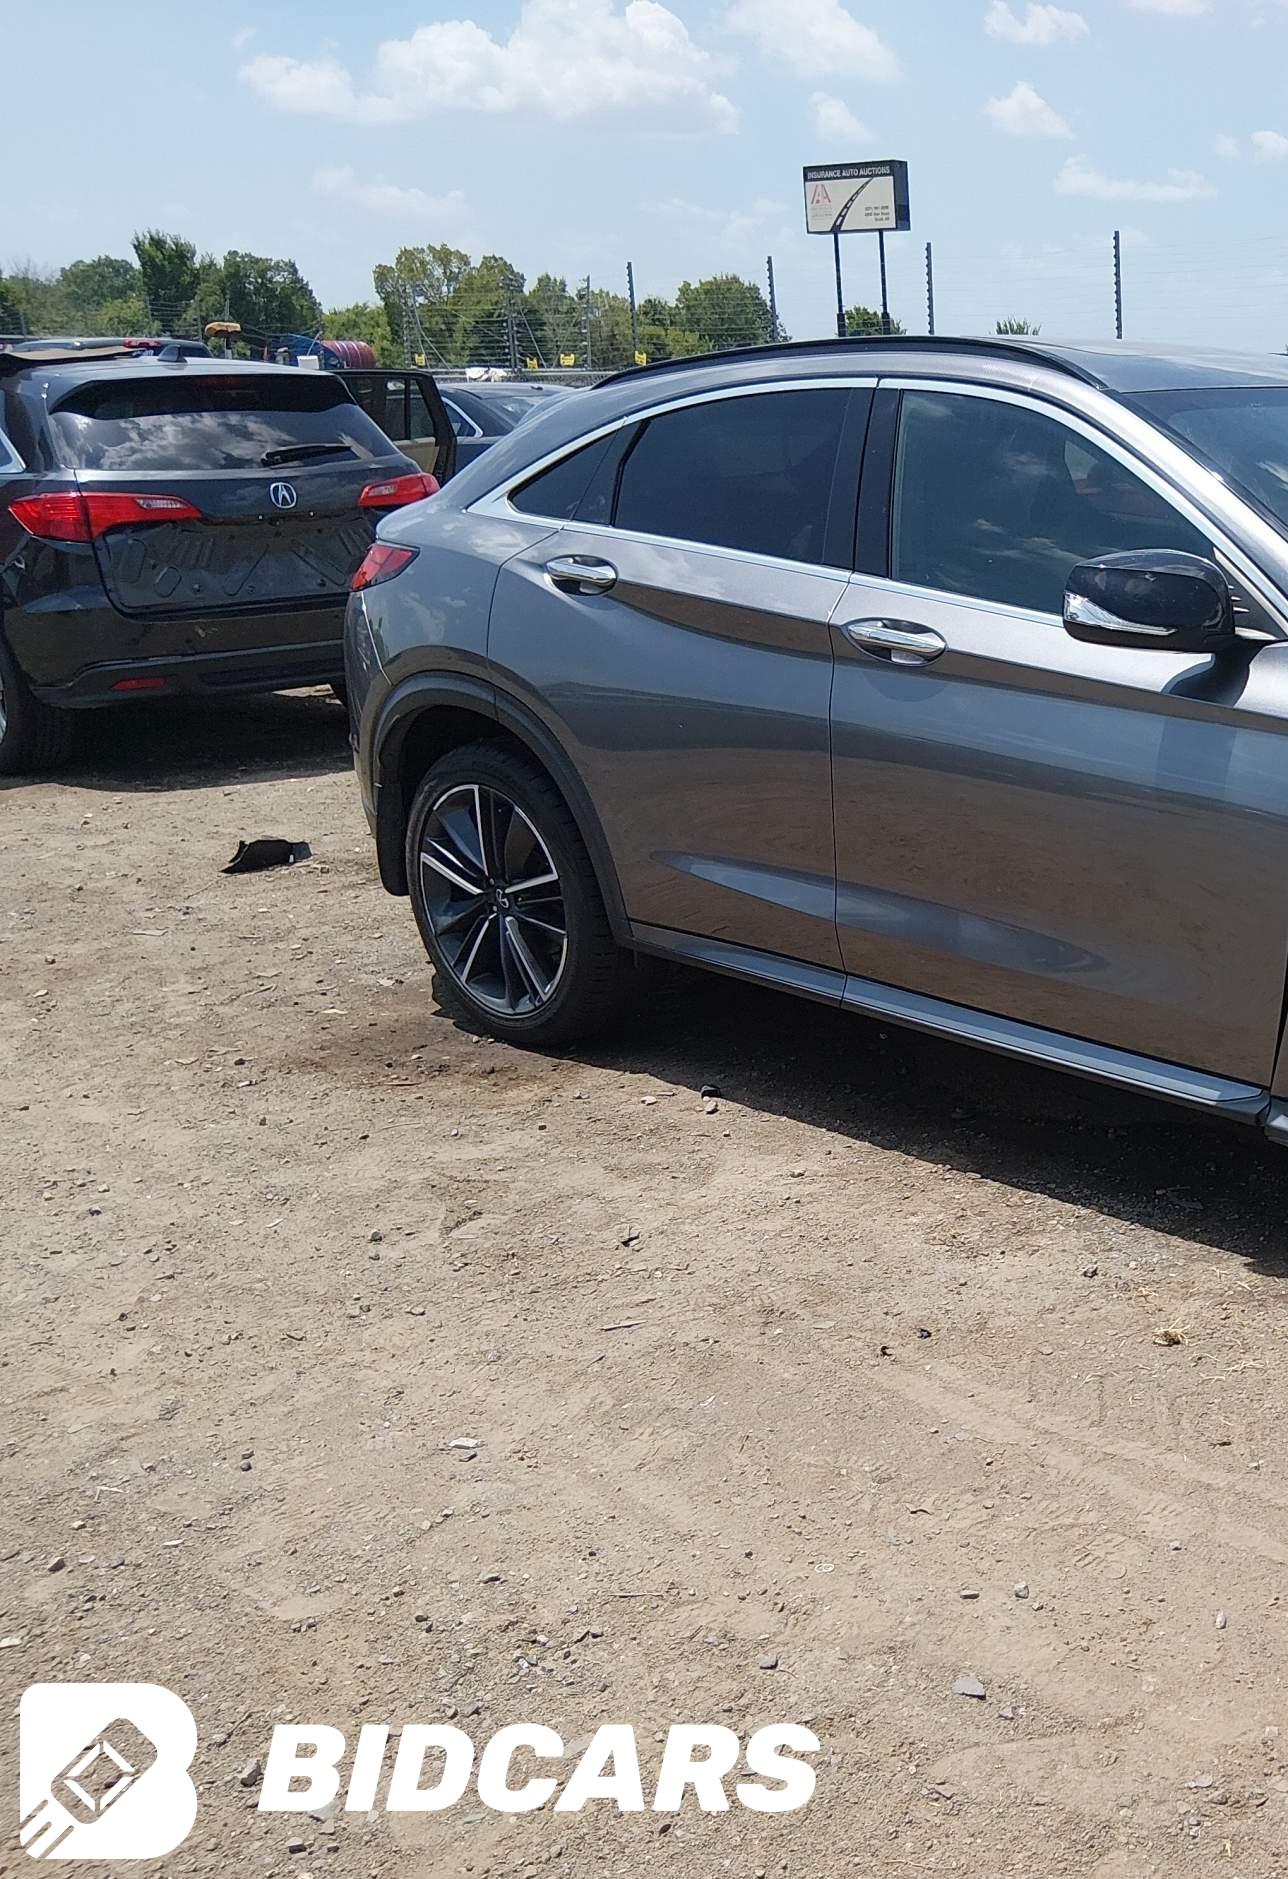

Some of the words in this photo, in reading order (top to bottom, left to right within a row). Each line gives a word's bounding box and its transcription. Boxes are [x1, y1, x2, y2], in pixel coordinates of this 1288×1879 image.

[807, 169, 841, 179] INSURANCE
[842, 168, 858, 177] AUTO
[859, 165, 891, 176] AUCTIONS
